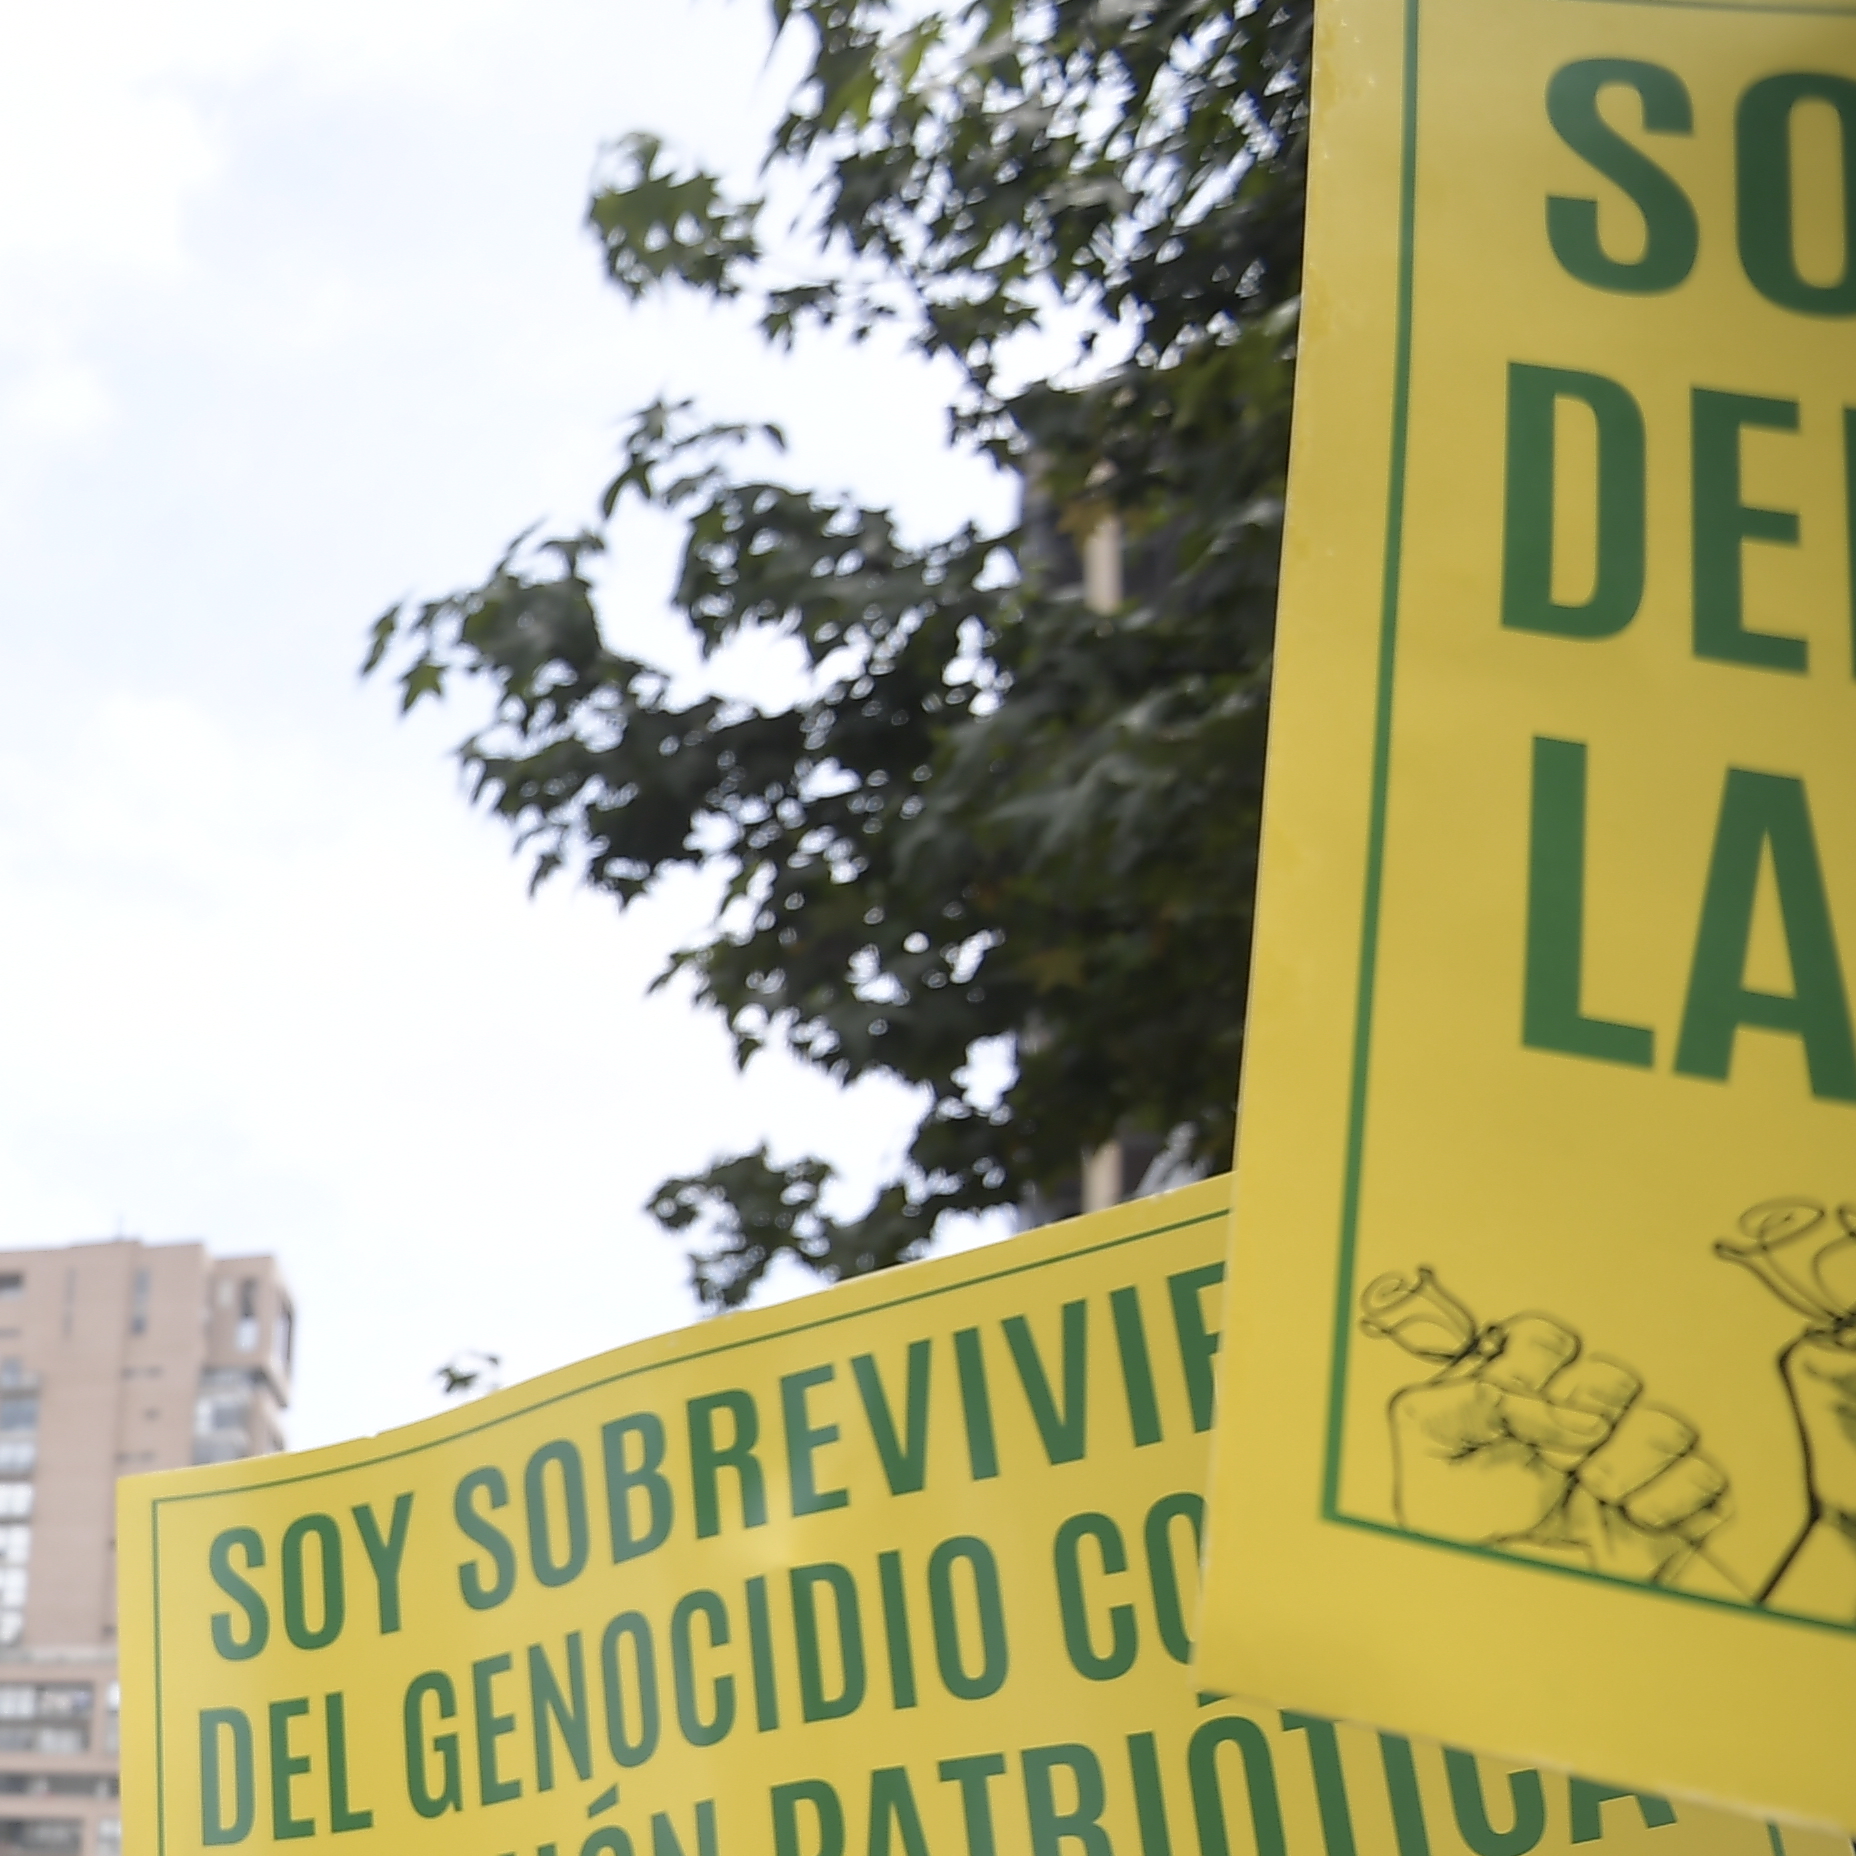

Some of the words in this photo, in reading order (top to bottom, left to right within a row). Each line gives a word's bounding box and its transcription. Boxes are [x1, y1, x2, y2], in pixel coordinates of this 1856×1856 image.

[1545, 55, 1856, 320] SO
[1499, 358, 1856, 684] DE
[1520, 730, 1856, 1106] LA
[207, 1491, 416, 1663] SOY
[456, 1261, 1227, 1614] SOBREVIVIE
[198, 1688, 373, 1847] DEL
[404, 1533, 1011, 1819] GENOCIDIO
